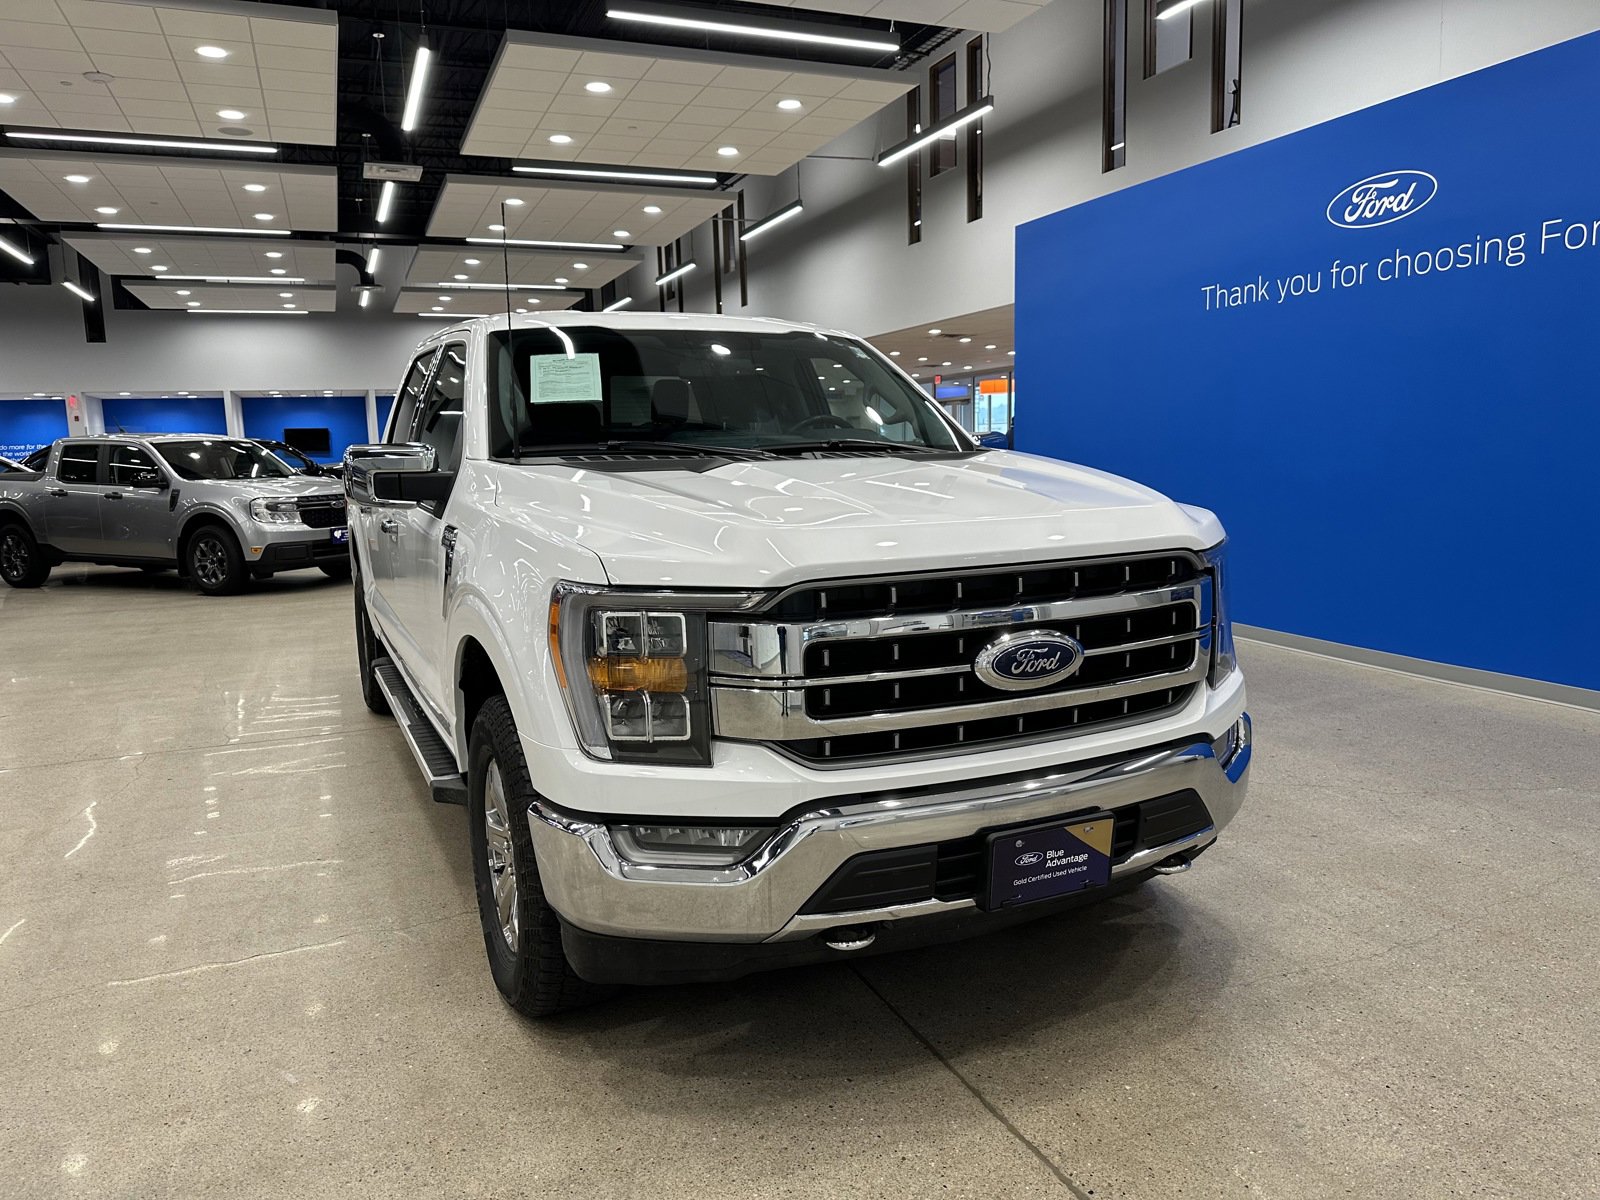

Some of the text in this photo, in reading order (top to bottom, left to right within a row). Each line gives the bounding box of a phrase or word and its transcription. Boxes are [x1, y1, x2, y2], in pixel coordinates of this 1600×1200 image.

[1344, 178, 1416, 223] Ford
[1201, 275, 1270, 311] Thank
[1277, 271, 1321, 304] you
[1330, 260, 1369, 289] for
[1377, 232, 1526, 282] choosing
[1011, 647, 1060, 674] Ford
[1020, 849, 1064, 864] Ford Blue
[1045, 852, 1089, 868] Advantage
[1013, 865, 1088, 886] Gold Certified Used Vehicle
